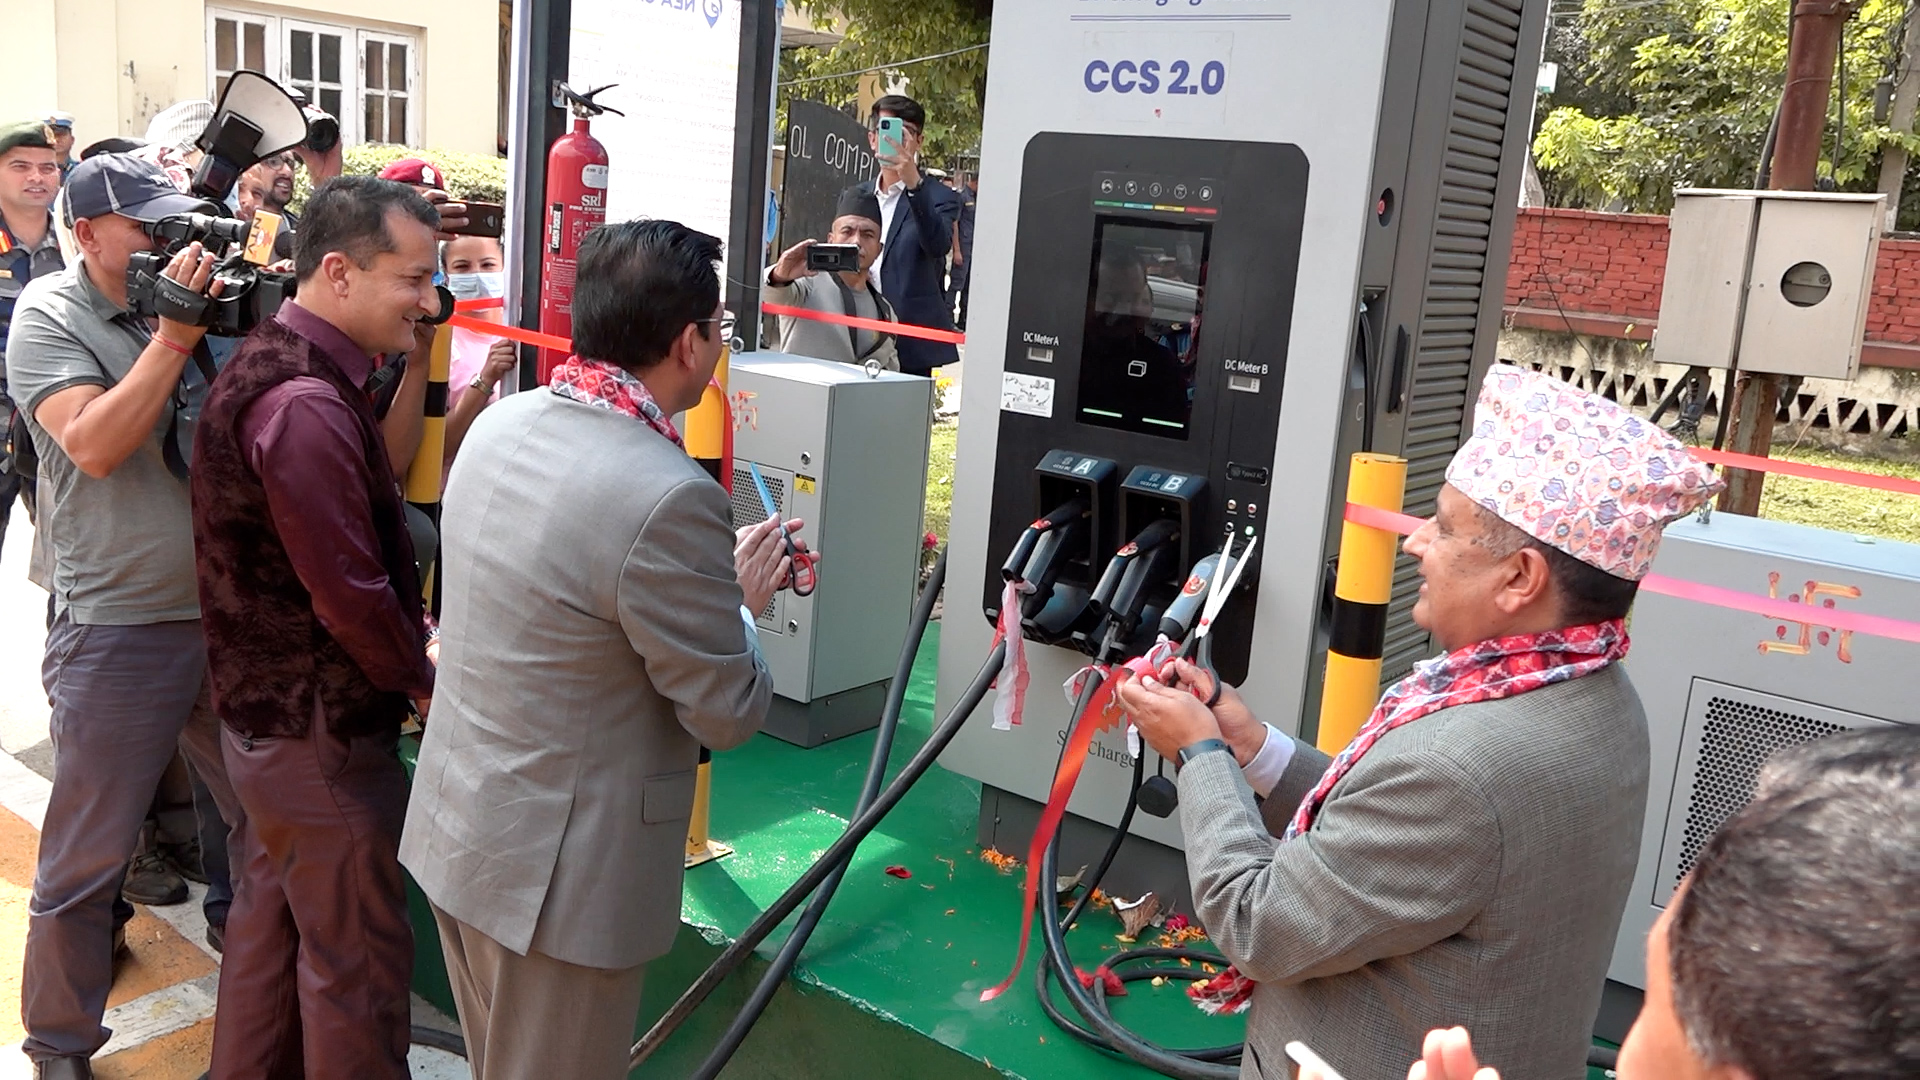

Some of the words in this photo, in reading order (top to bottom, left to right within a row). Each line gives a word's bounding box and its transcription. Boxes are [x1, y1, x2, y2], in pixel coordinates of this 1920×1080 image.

[1084, 60, 1161, 94] CCS
[1167, 60, 1226, 95] 2.0
[790, 124, 812, 159] OL
[162, 291, 191, 309] SONY
[1023, 331, 1034, 343] DC
[1034, 333, 1054, 345] Meter
[1053, 336, 1060, 346] A
[1224, 359, 1237, 371] DC
[1237, 361, 1262, 374] Meter
[1261, 364, 1269, 375] B
[1074, 459, 1092, 474] A
[1163, 476, 1182, 491] B
